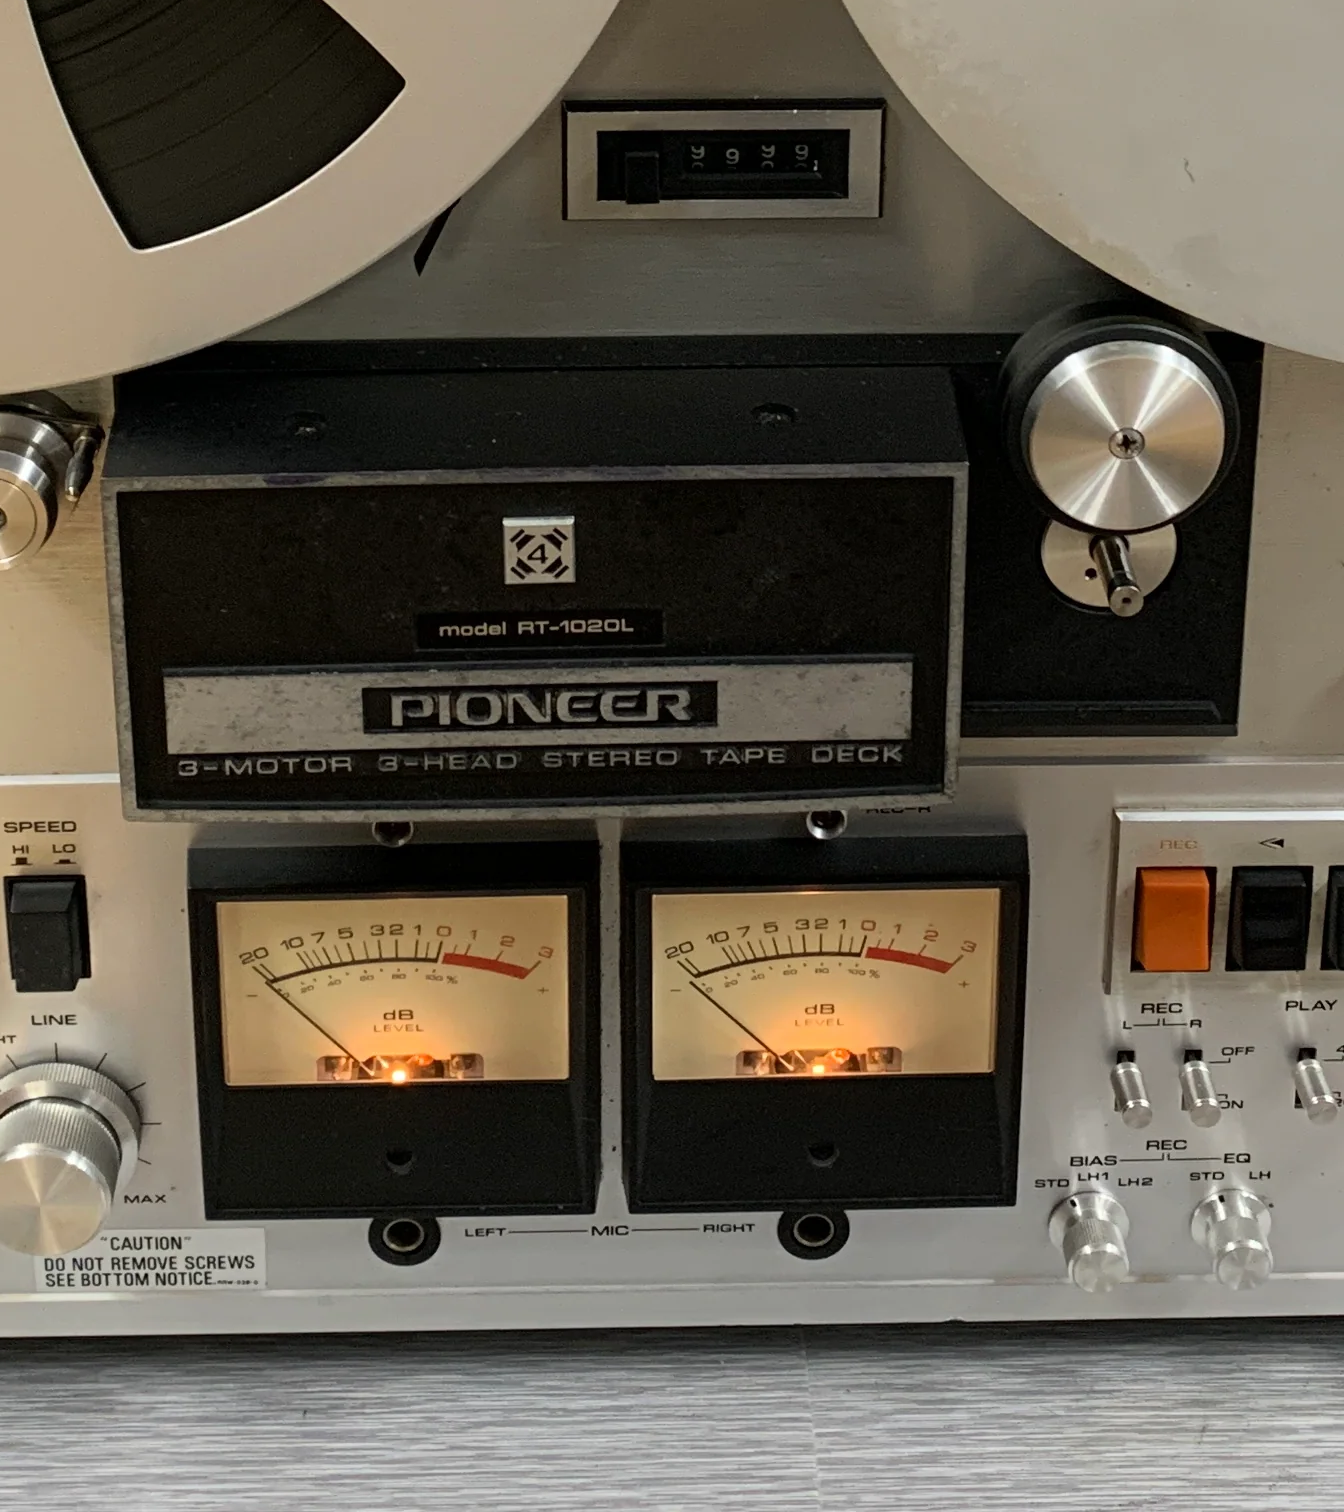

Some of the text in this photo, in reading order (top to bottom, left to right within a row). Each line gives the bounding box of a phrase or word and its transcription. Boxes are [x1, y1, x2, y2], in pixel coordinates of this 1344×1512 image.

[439, 618, 634, 636] model RT-1020L
[390, 688, 694, 728] PIONEER
[178, 744, 904, 777] 3-MOTOR 3-HEAD STEREO TAPE DECK
[3, 821, 77, 834] SPEED
[12, 843, 77, 855] HI LO
[1160, 839, 1198, 850] REC
[239, 923, 554, 966] 20 10 7 5 3 2 1 0 1 2 3
[664, 918, 977, 960] 20 10 7 5 3 2 1 0 1 2 3
[805, 1003, 835, 1015] dB
[1140, 1002, 1184, 1014] REC
[1285, 999, 1338, 1011] PLAY
[30, 1013, 78, 1026] LINE
[383, 1009, 414, 1020] dB
[794, 1017, 845, 1027] LEVEL
[1122, 1019, 1202, 1030] L R
[373, 1024, 424, 1033] LEVEL
[1221, 1046, 1255, 1057] OFF
[1218, 1099, 1244, 1109] ON
[1145, 1139, 1188, 1151] REC
[1069, 1152, 1251, 1167] BIAS EQ
[1034, 1172, 1153, 1188] STD LH1 LH2
[1189, 1170, 1271, 1181] STD LH
[123, 1194, 168, 1205] MAX
[464, 1222, 756, 1237] LEFT MIC RIGHT
[44, 1255, 256, 1272] DO NOT REMOVE SCREWS
[45, 1273, 75, 1287] SEE
[81, 1272, 150, 1287] BOTTOM
[155, 1271, 213, 1286] NOTICE
